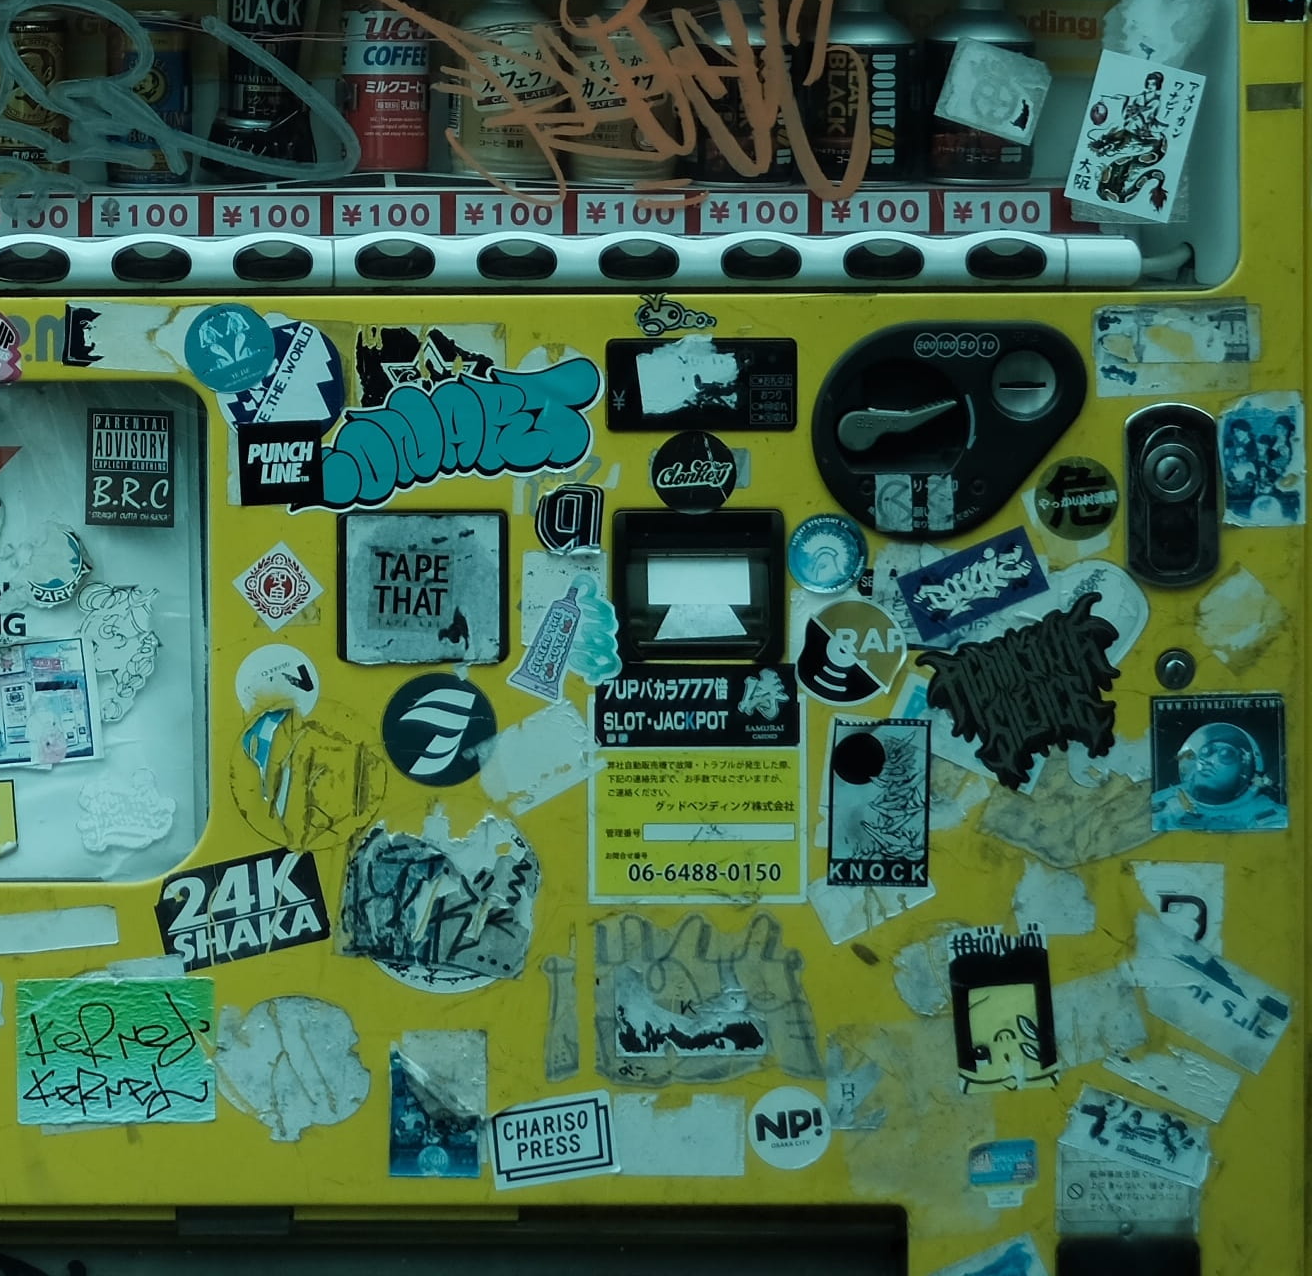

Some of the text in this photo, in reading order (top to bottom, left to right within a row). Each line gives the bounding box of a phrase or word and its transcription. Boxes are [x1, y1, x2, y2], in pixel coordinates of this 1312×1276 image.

[363, 43, 427, 66] COFFEE
[464, 203, 553, 225] ¥100
[954, 201, 1040, 224] ¥100
[95, 415, 166, 430] PARENTAL
[94, 432, 166, 460] ADVISORY
[247, 441, 314, 464] PUNCH
[657, 460, 733, 488] donkey
[92, 475, 169, 509] B.R.C
[1045, 465, 1107, 529] 危
[375, 551, 450, 583] TAPE
[373, 585, 448, 616] THAT
[531, 610, 563, 675] SPREAD THE
[549, 634, 566, 665] CUTE
[836, 628, 904, 654] RAP
[655, 800, 795, 812] グッドベンディング株式会社
[628, 862, 782, 882] 06-6488-0150
[828, 862, 925, 881] KNOCK
[164, 852, 308, 932] 24K
[172, 903, 322, 963] SHAKA
[502, 1110, 589, 1142] CHARISO
[754, 1107, 824, 1142] NP!
[516, 1134, 582, 1162] PRESS
